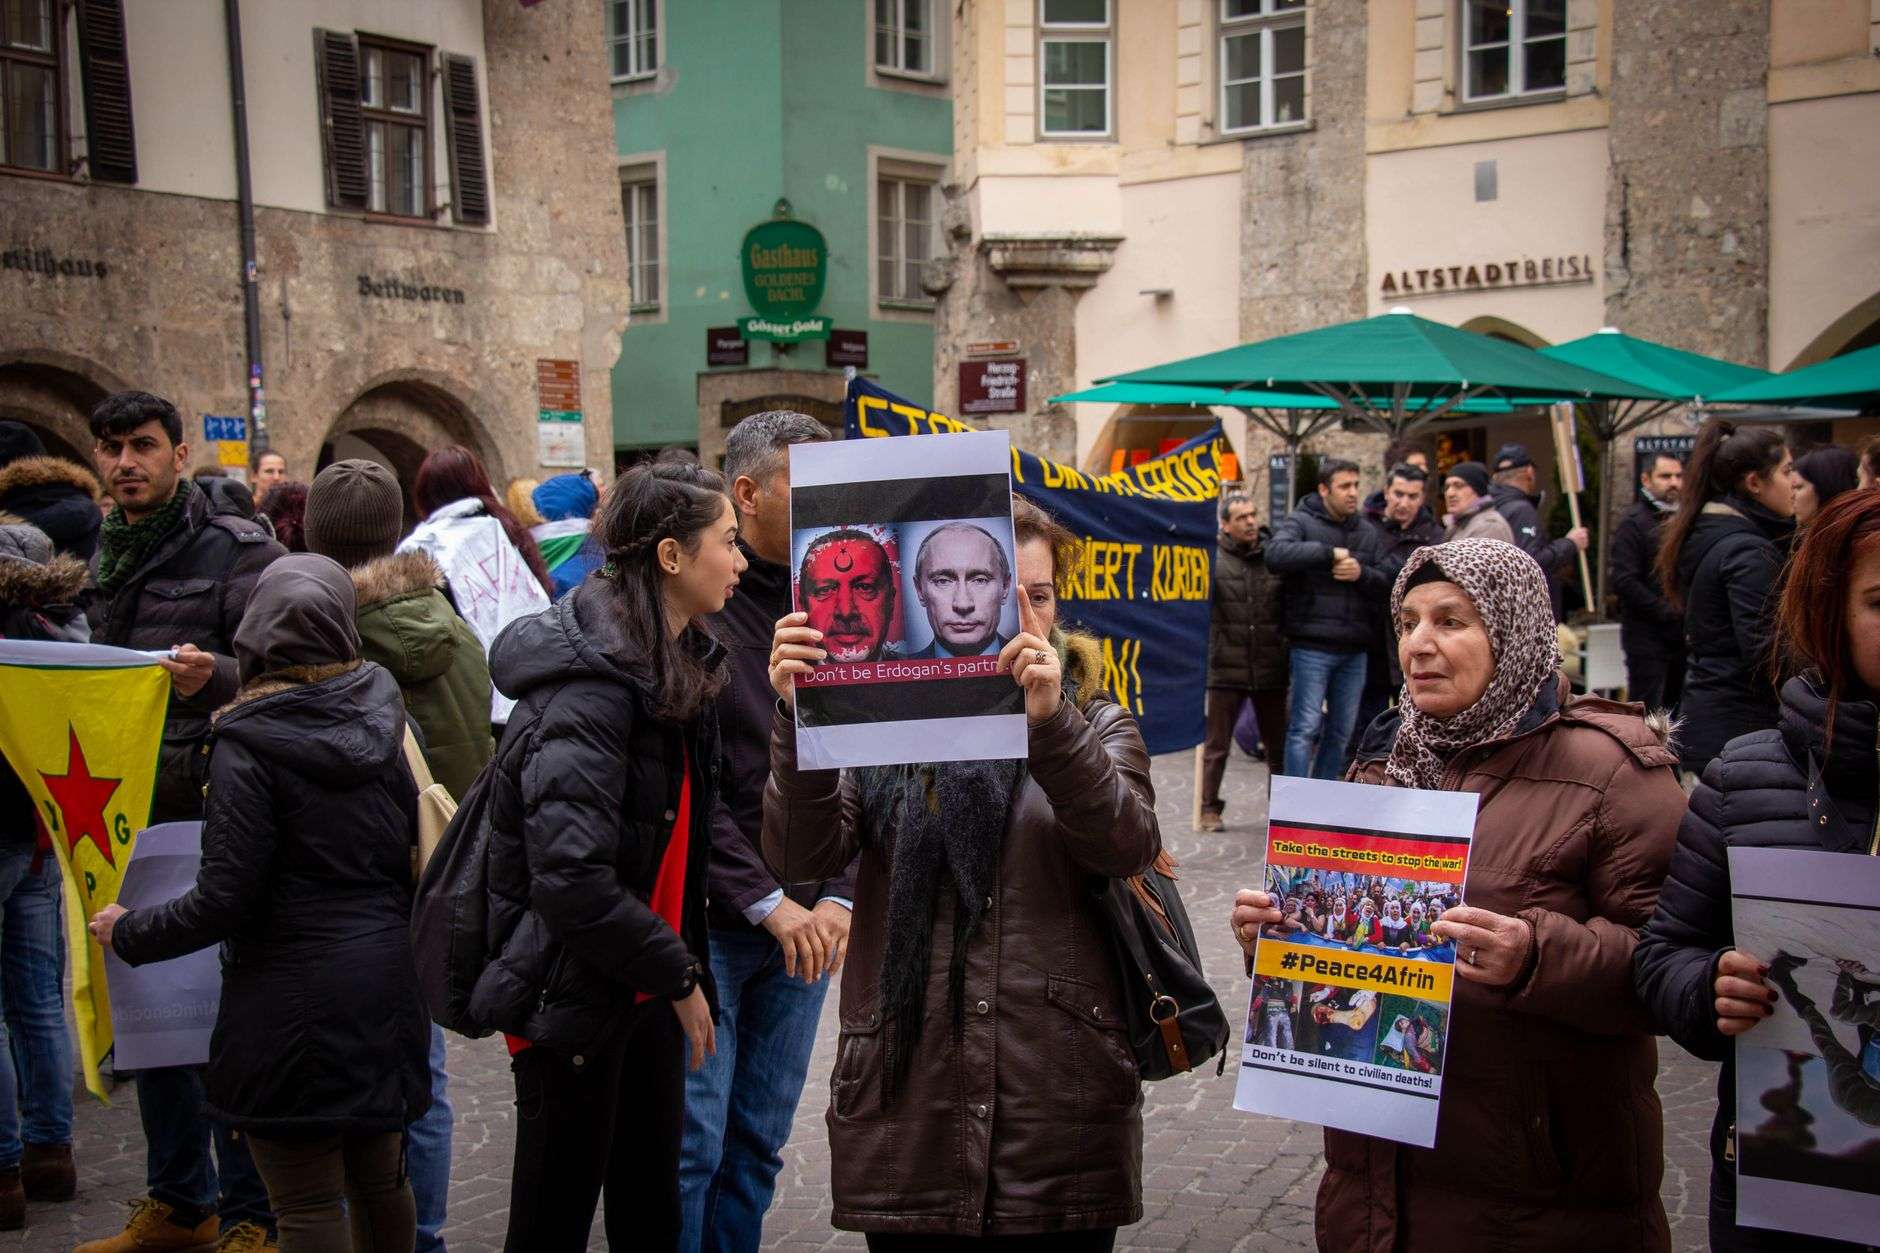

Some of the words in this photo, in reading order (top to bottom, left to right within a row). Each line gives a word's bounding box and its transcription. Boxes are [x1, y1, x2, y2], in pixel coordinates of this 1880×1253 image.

[751, 243, 818, 269] Gasthaus
[1381, 254, 1595, 292] ALTSTADTBEISL
[792, 319, 824, 335] Gold
[1151, 543, 1211, 602] KURDEN
[804, 665, 848, 683] Don't
[852, 666, 871, 681] be
[877, 660, 951, 682] Erdogan's
[114, 812, 131, 845] G
[1274, 841, 1303, 854] Take
[1307, 844, 1328, 857] the
[1332, 848, 1378, 863] streets
[1379, 853, 1394, 864] to
[1396, 855, 1421, 869] stop
[1423, 857, 1440, 869] the
[1441, 859, 1462, 870] war!
[84, 870, 97, 900] P
[1280, 951, 1435, 991] #Peace4Afrin
[1251, 1048, 1286, 1064] Don't
[1289, 1052, 1305, 1067] be
[1307, 1057, 1340, 1073] silent
[1343, 1062, 1356, 1075] to
[1358, 1066, 1393, 1082] civilian
[1395, 1072, 1433, 1089] deaths!
